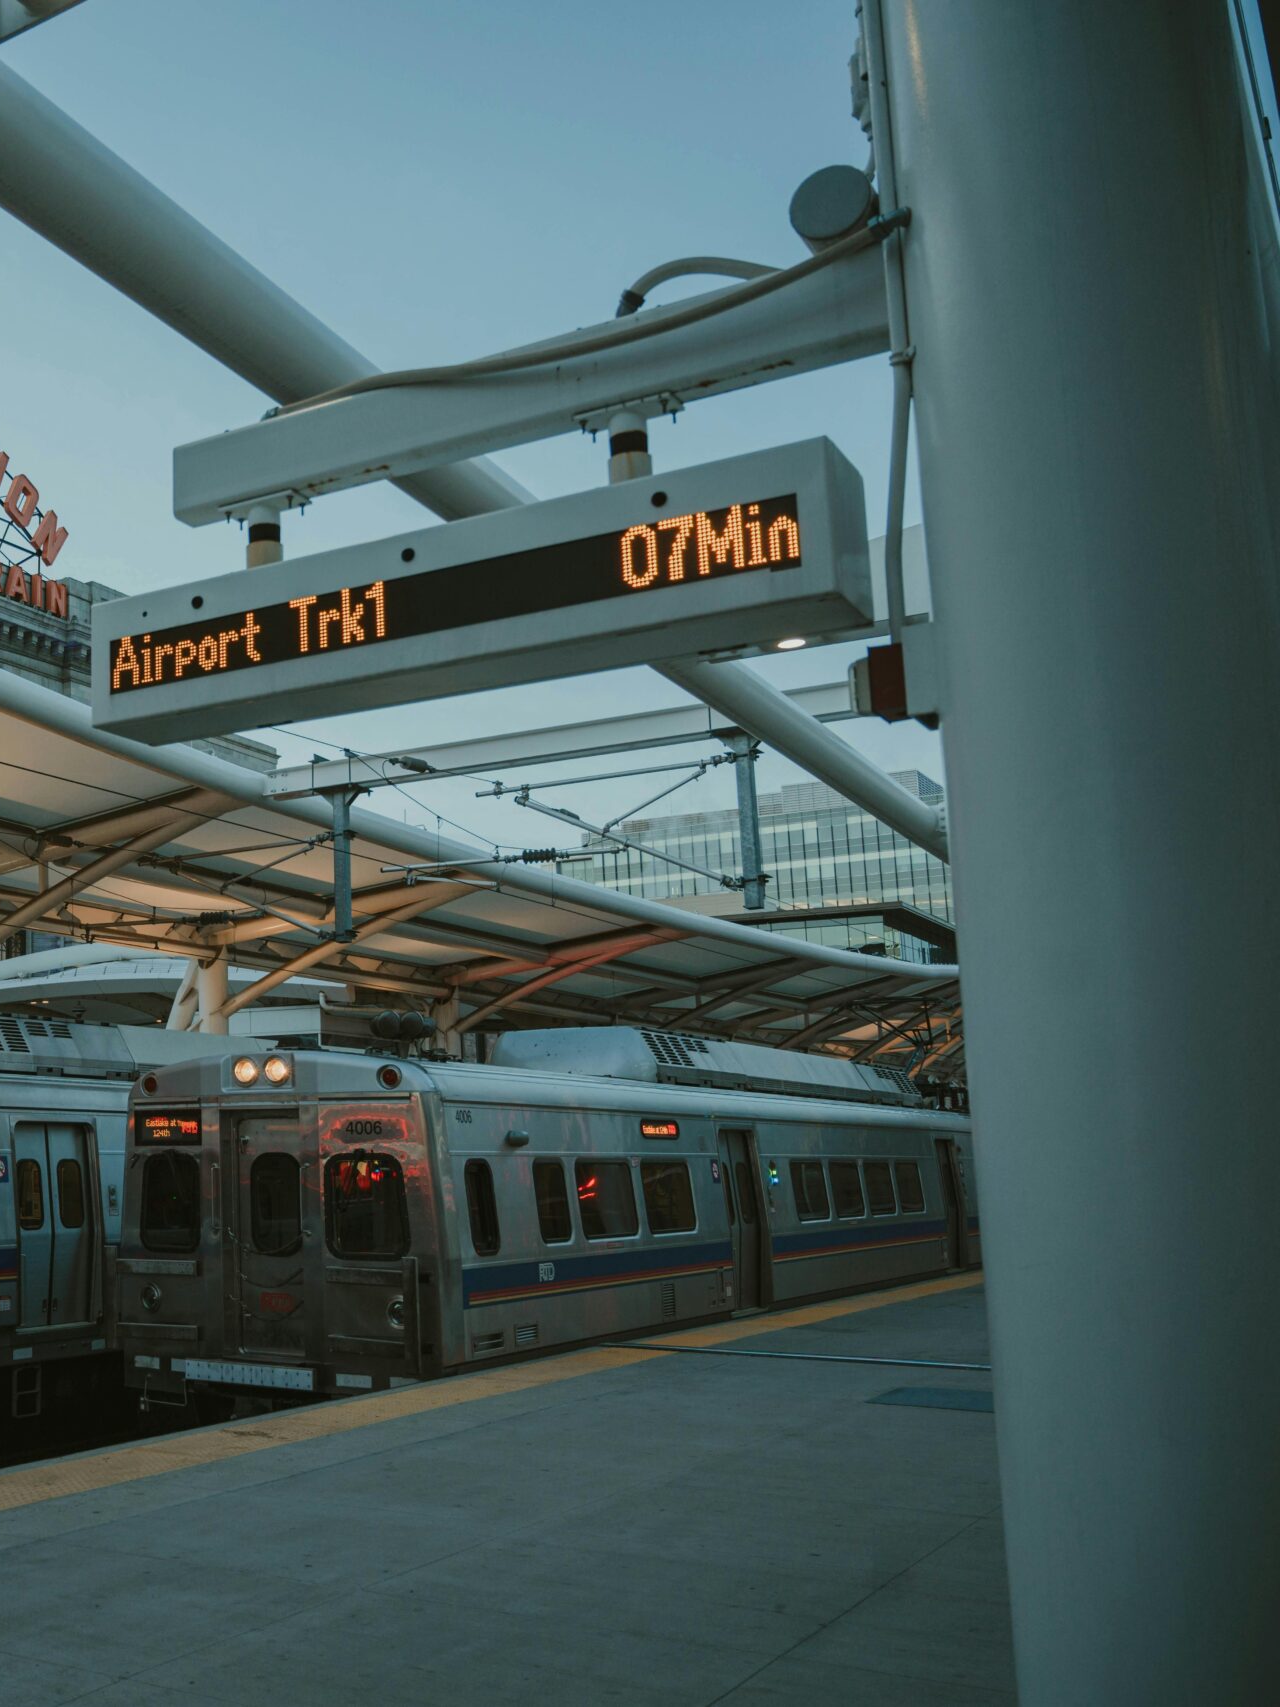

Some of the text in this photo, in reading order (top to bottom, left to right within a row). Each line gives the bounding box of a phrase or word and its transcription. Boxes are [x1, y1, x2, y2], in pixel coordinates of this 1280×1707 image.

[112, 504, 800, 689] Airport Trk1 07Min
[145, 1118, 169, 1127] Eastlake
[170, 1118, 177, 1127] at
[455, 1109, 473, 1124] 4006
[153, 1129, 171, 1137] 124th
[345, 1120, 383, 1135] 4006
[538, 1262, 556, 1283] RTD
